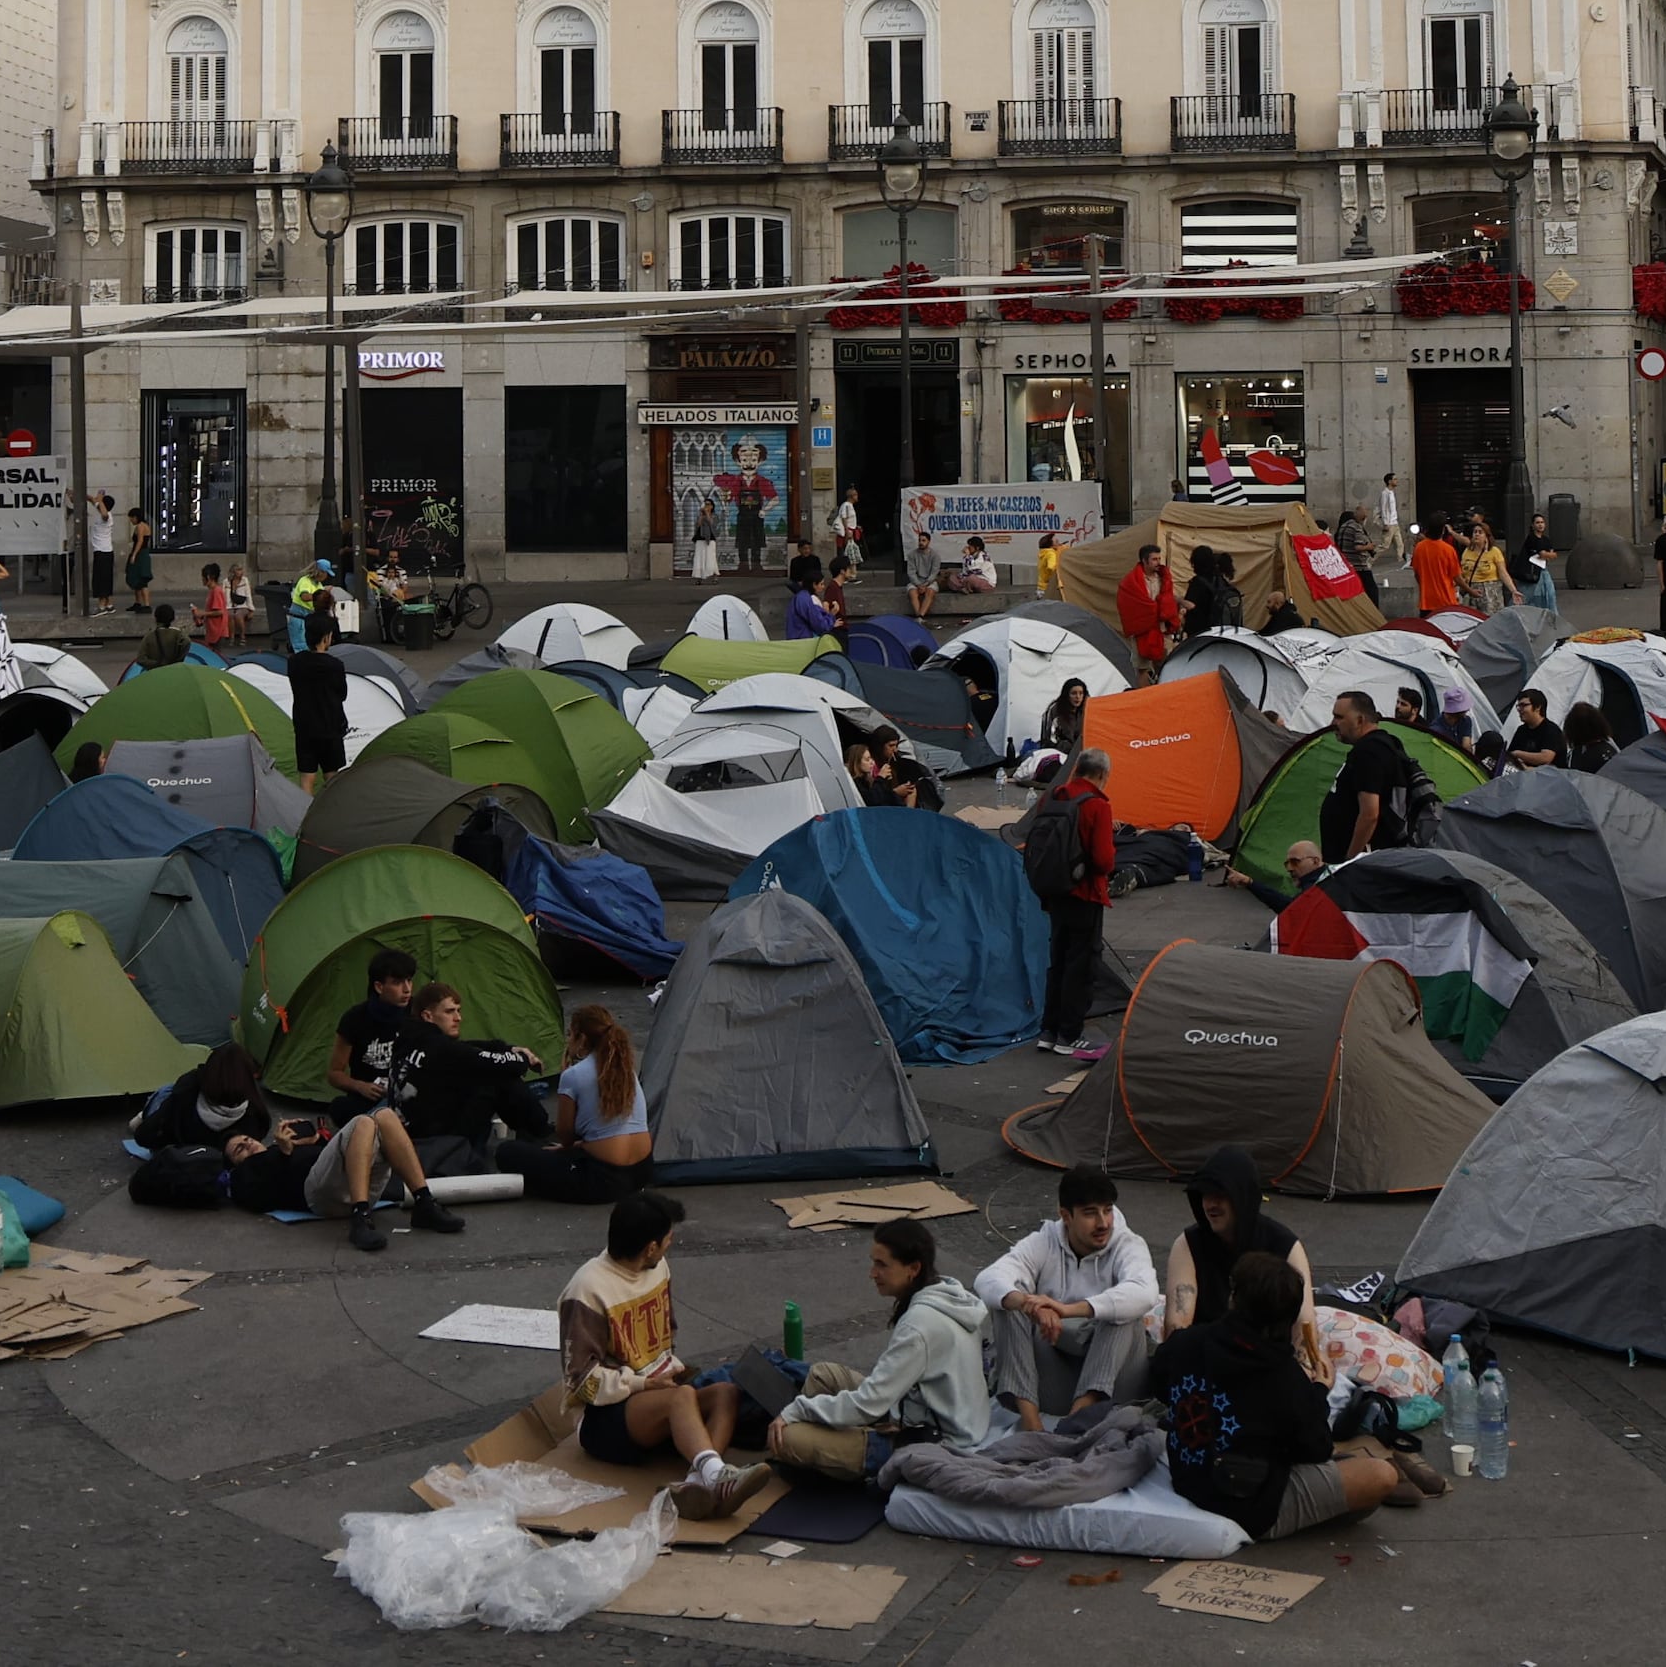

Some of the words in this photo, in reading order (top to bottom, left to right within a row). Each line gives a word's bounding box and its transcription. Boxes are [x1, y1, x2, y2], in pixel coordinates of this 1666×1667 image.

[358, 351, 445, 369] PRIMOR
[680, 349, 776, 368] PALAZZO
[646, 410, 717, 423] HELADOS
[818, 429, 826, 439] H
[371, 478, 438, 493] PRIMOR
[955, 496, 988, 514] JEFES,
[999, 495, 1042, 513] CASEROS
[928, 514, 978, 533] QUEREMOS
[980, 513, 993, 531] UN
[993, 513, 1027, 530] MUNDO
[1029, 513, 1060, 531] NUEVO
[1129, 733, 1191, 748] Quechua
[147, 777, 211, 788] Quechua
[1184, 1029, 1278, 1046] Quechua
